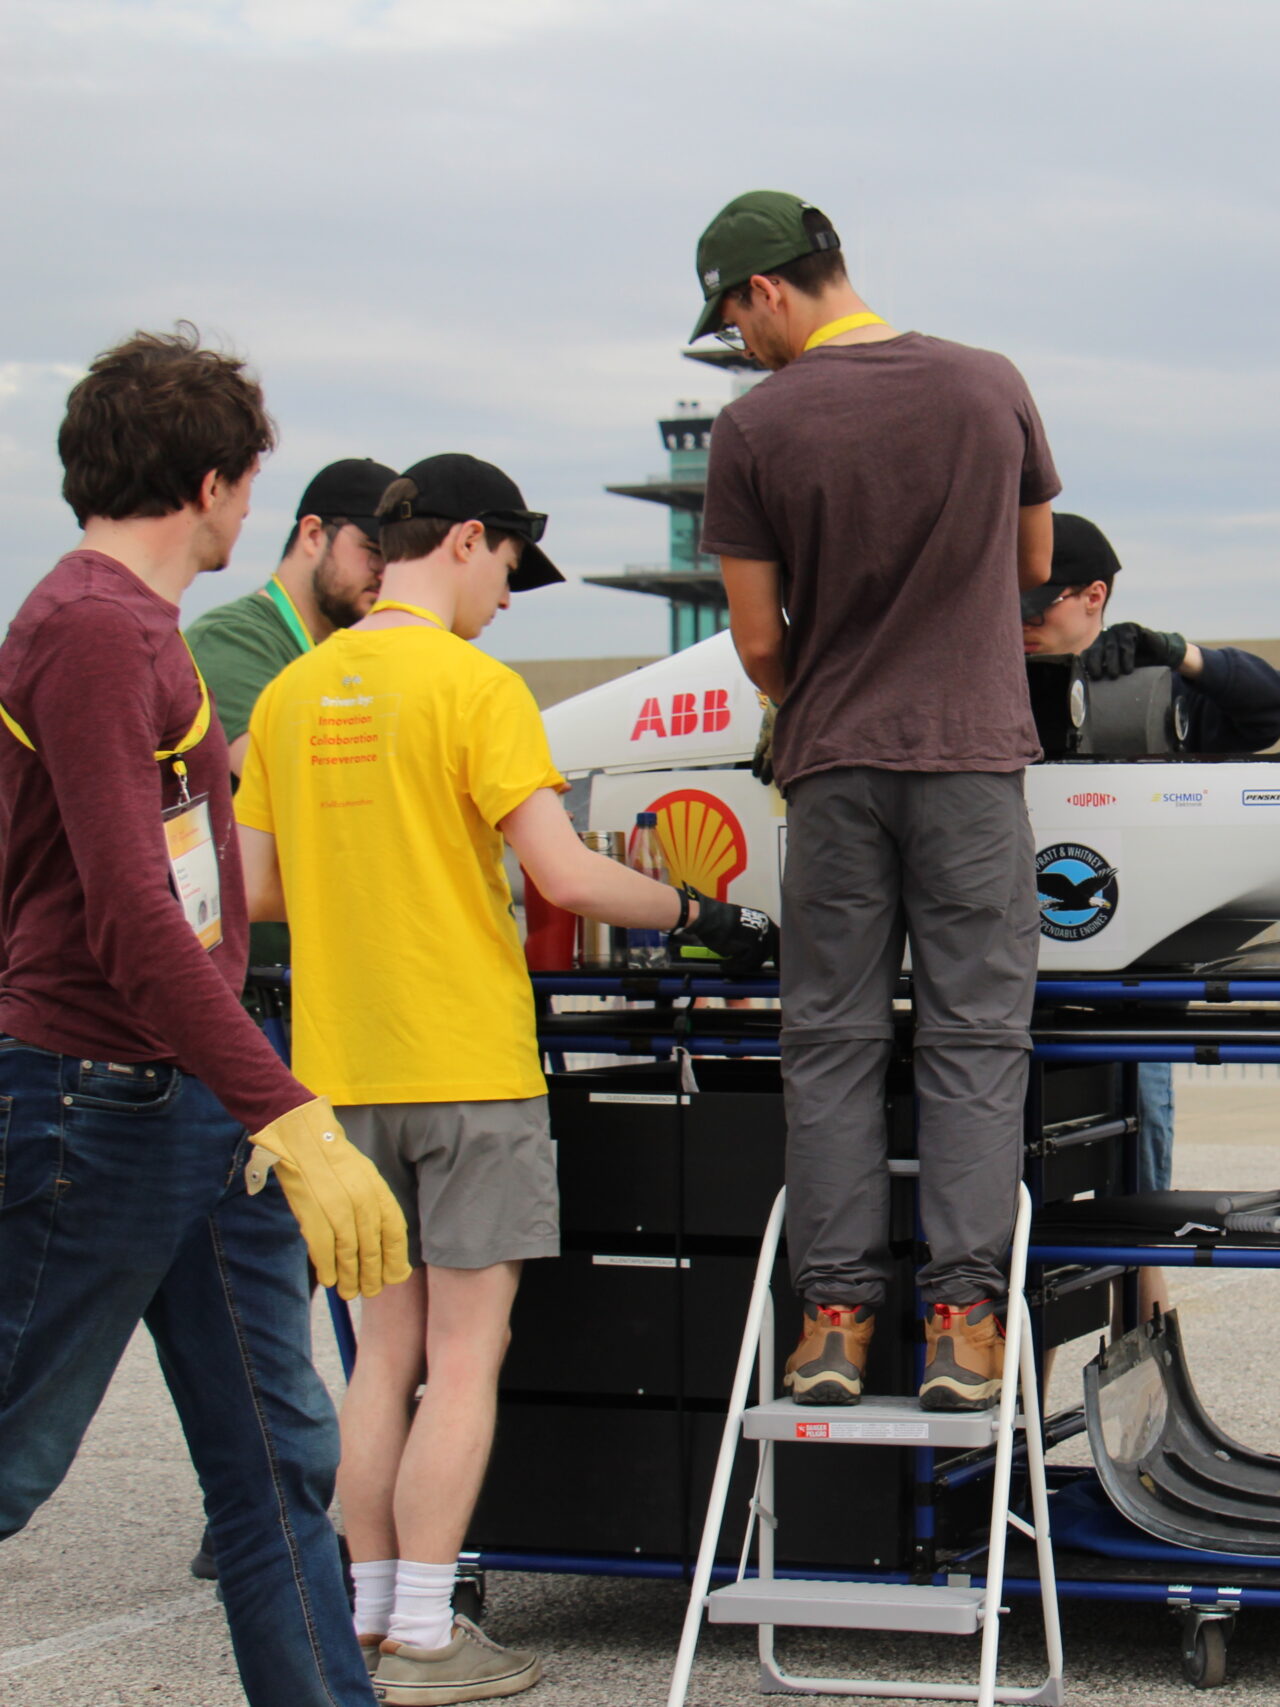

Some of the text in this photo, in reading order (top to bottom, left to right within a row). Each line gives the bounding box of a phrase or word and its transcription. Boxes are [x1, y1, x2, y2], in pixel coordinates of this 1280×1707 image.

[319, 715, 373, 726] Innovation
[630, 689, 731, 741] ABB
[310, 732, 379, 746] Collaboration
[311, 754, 378, 766] Perseverance
[1072, 792, 1111, 807] DUPONT
[1163, 793, 1203, 802] SCHMID
[1060, 847, 1066, 857] &
[1068, 847, 1103, 869] WHITNEY
[1080, 913, 1108, 937] ENGINES
